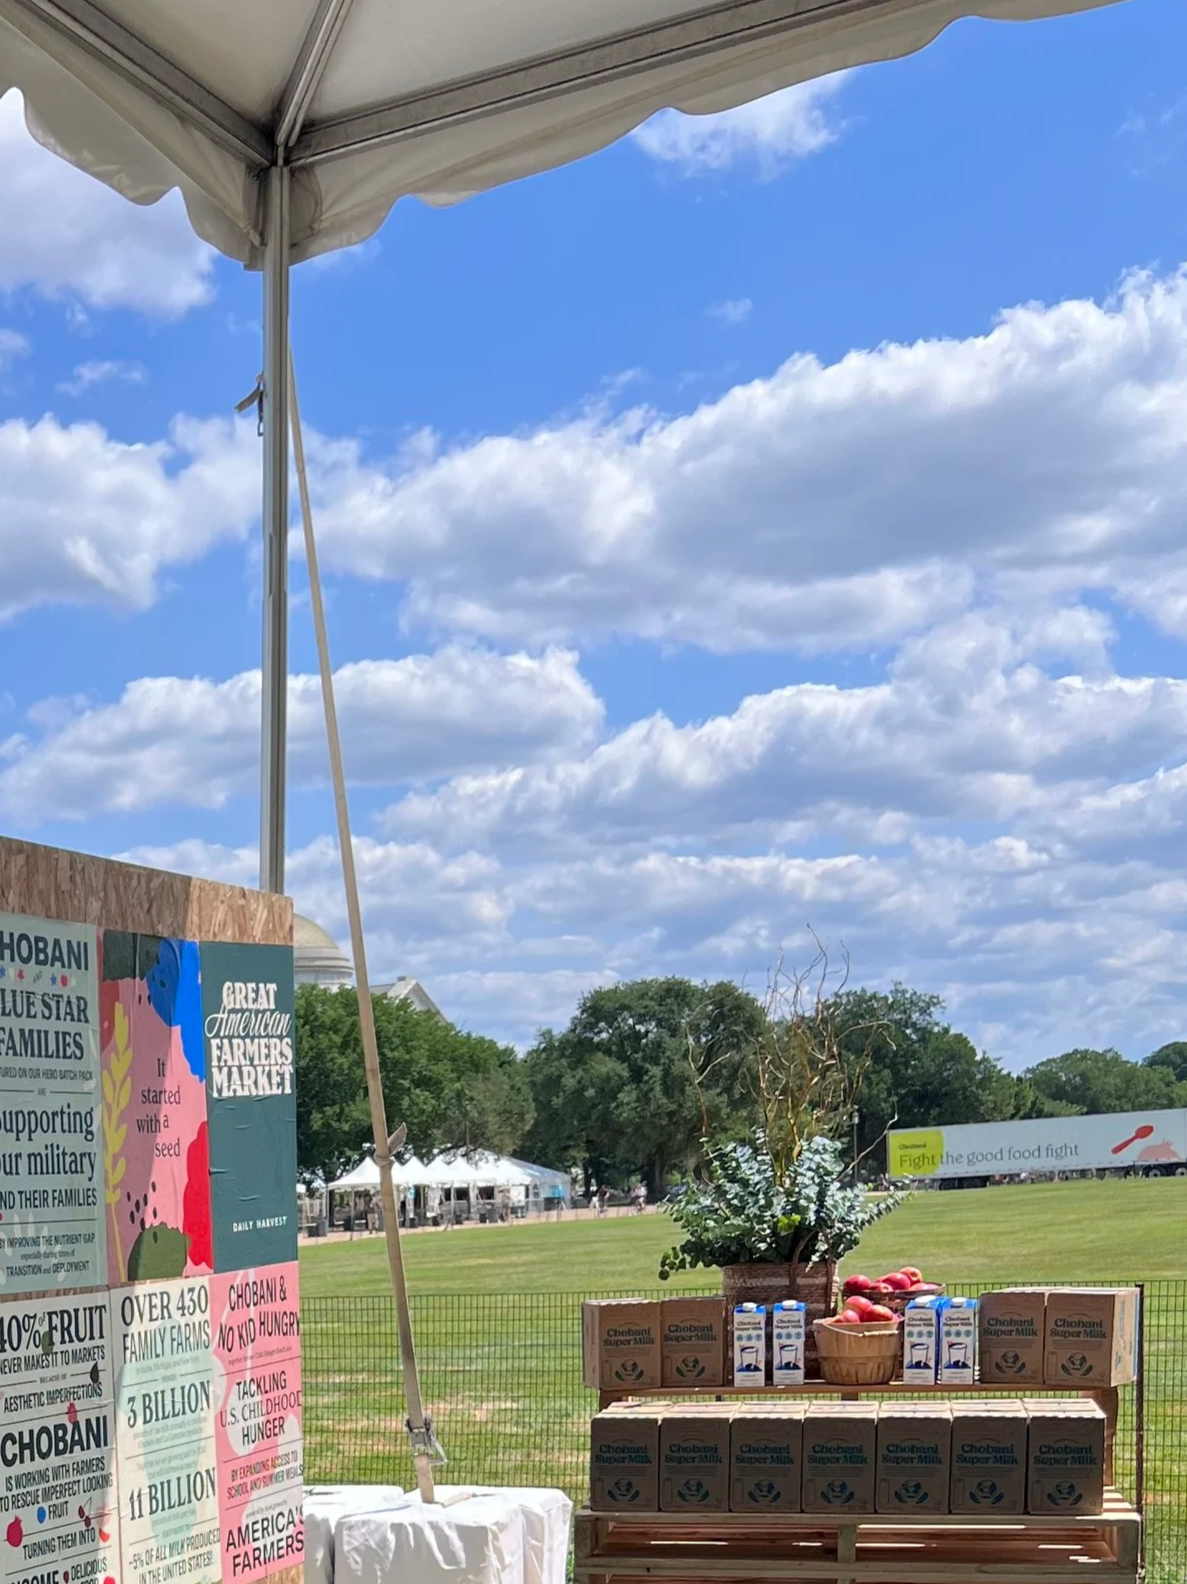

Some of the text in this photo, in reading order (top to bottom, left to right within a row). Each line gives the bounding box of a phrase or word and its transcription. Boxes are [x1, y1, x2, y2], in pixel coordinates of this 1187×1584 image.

[41, 993, 89, 1024] STAR
[222, 981, 276, 1010] GREAT
[204, 1004, 292, 1038] American
[210, 1038, 292, 1066] FARMERS
[18, 1069, 27, 1078] ON
[29, 1069, 40, 1079] OUR
[42, 1070, 57, 1079] HERO
[59, 1070, 77, 1080] BATCH
[79, 1071, 93, 1080] PACK
[157, 1057, 165, 1078] It
[211, 1065, 293, 1098] MARKET
[141, 1085, 181, 1106] started
[136, 1114, 169, 1133] with a
[154, 1140, 180, 1157] seed
[899, 1143, 1080, 1170] Fight the good food fight
[28, 1143, 96, 1182] military
[18, 1190, 48, 1208] THEIR
[52, 1188, 97, 1208] FAMILIES
[233, 1216, 287, 1233] DAILY HARVEST
[121, 1285, 208, 1326] OVER 430
[228, 1275, 287, 1312] CHOBANI &
[983, 1327, 1038, 1338] Super Milk
[987, 1317, 1034, 1327] Chobani
[1050, 1328, 1106, 1338] Super Milk
[1054, 1318, 1103, 1329] Chobani
[123, 1319, 210, 1364] FAMILY FARMS
[0, 1415, 108, 1467] CHOBANI
[242, 1416, 285, 1446] HUNGER
[595, 1454, 652, 1465] Super Milk
[599, 1445, 648, 1454] Chobani
[129, 1488, 144, 1521] 11
[148, 1468, 216, 1516] BILLION
[233, 1531, 304, 1577] FARMERS
